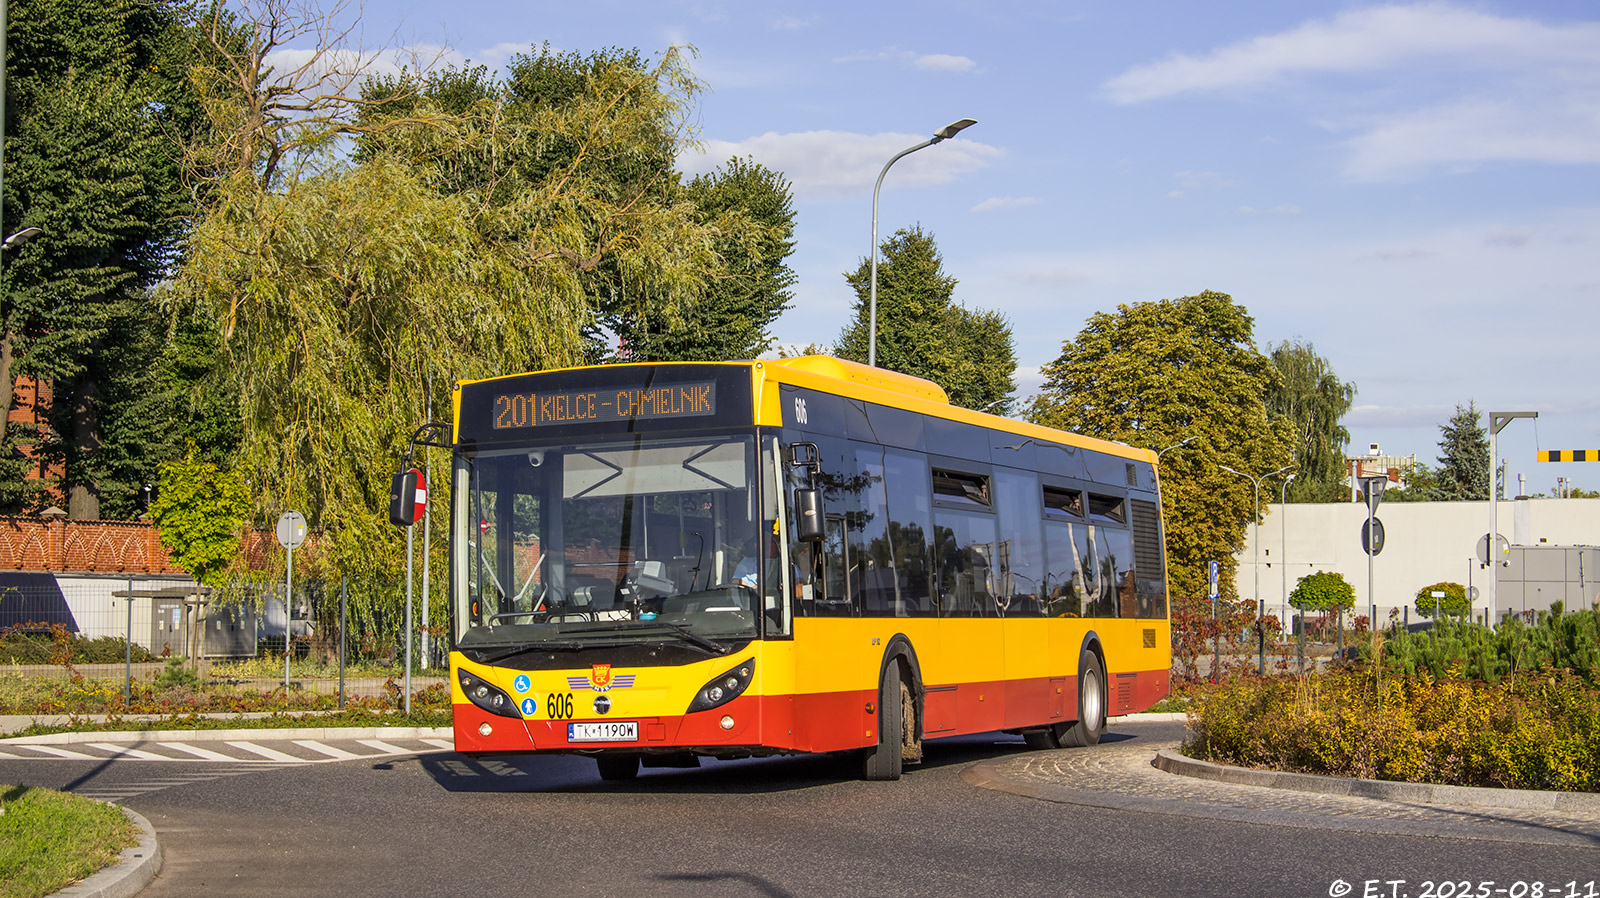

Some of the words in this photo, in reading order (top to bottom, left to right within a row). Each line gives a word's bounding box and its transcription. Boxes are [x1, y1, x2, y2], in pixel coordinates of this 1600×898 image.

[496, 393, 536, 428] 201
[541, 393, 597, 421] KIELCE
[616, 385, 710, 416] CHMIELNIK
[794, 397, 808, 425] 606
[547, 692, 573, 719] 606
[577, 725, 592, 738] TK
